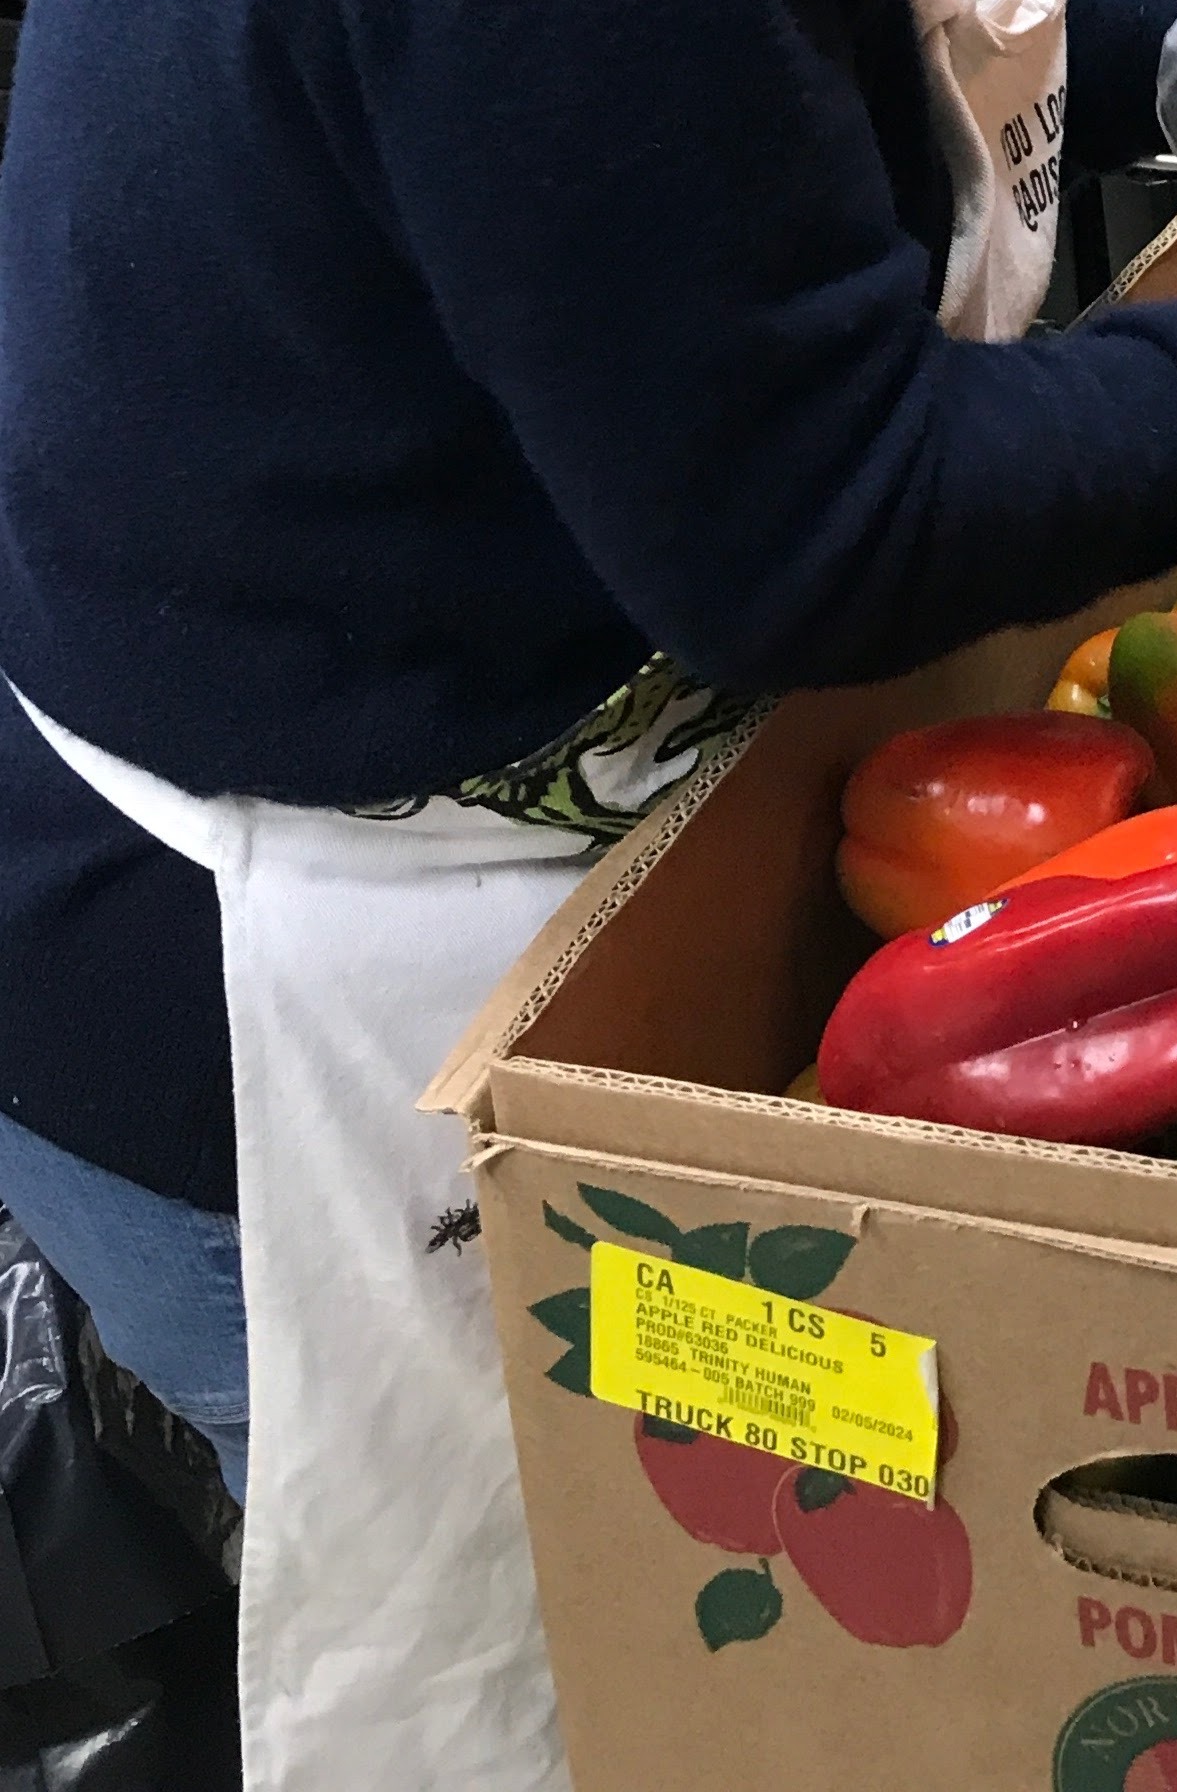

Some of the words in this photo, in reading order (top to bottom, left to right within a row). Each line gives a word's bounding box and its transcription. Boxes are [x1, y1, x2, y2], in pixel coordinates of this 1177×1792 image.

[637, 1263, 675, 1295] CA
[636, 1302, 694, 1329] APPLE
[702, 1321, 738, 1342] RED
[746, 1333, 844, 1374] DELICIOUS
[726, 1313, 778, 1338] PACKER
[762, 1301, 774, 1324] 1
[788, 1307, 825, 1340] CS
[870, 1332, 887, 1358] 5
[689, 1347, 750, 1376] TRINITY
[755, 1367, 811, 1395] HUMAN
[735, 1377, 784, 1403] BATCH
[636, 1390, 732, 1439] TRUCK
[744, 1422, 778, 1451] 80
[790, 1437, 868, 1475] STOP
[879, 1464, 930, 1498] 030
[831, 1405, 914, 1442] 02/05/2024
